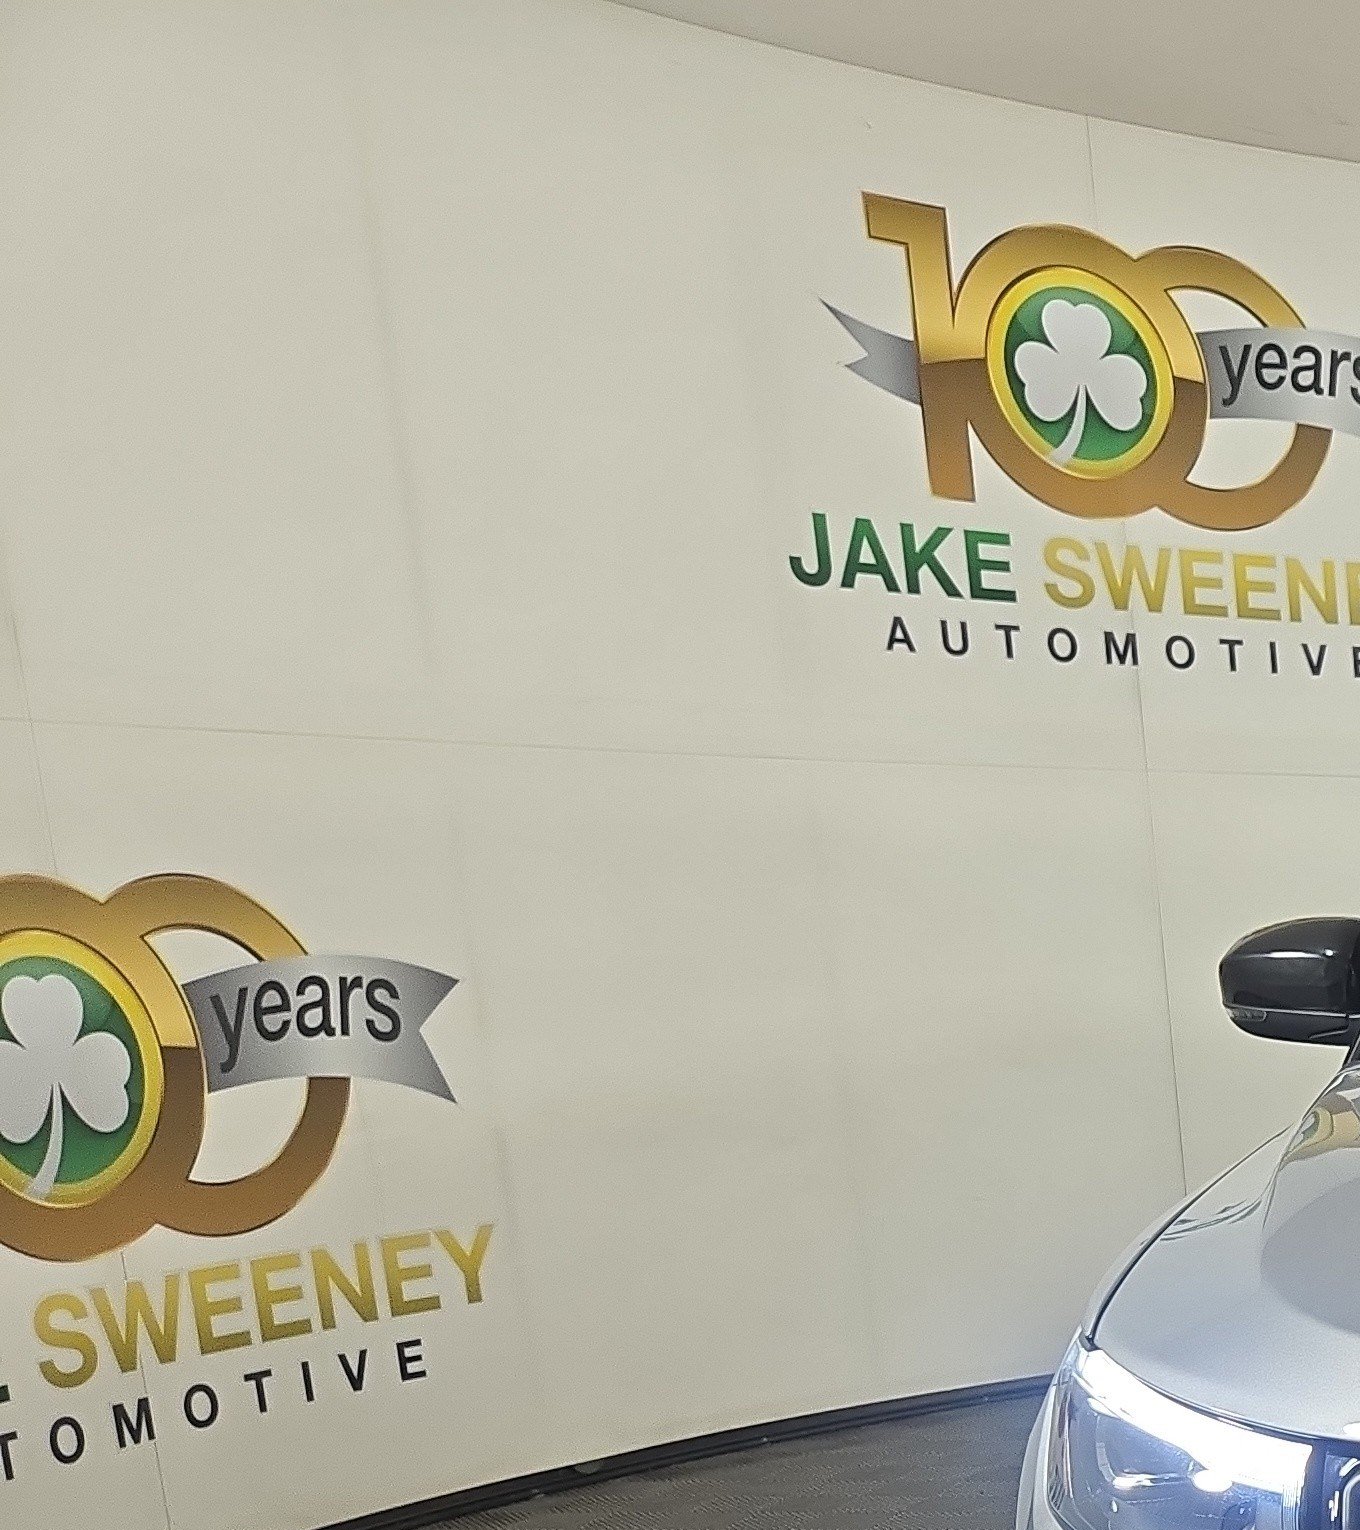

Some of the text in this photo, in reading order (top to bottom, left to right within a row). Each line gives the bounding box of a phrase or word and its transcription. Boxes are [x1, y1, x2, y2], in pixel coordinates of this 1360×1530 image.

[788, 512, 1018, 604] JAKE
[208, 974, 402, 1073] years
[32, 1223, 495, 1389] SWEENEY
